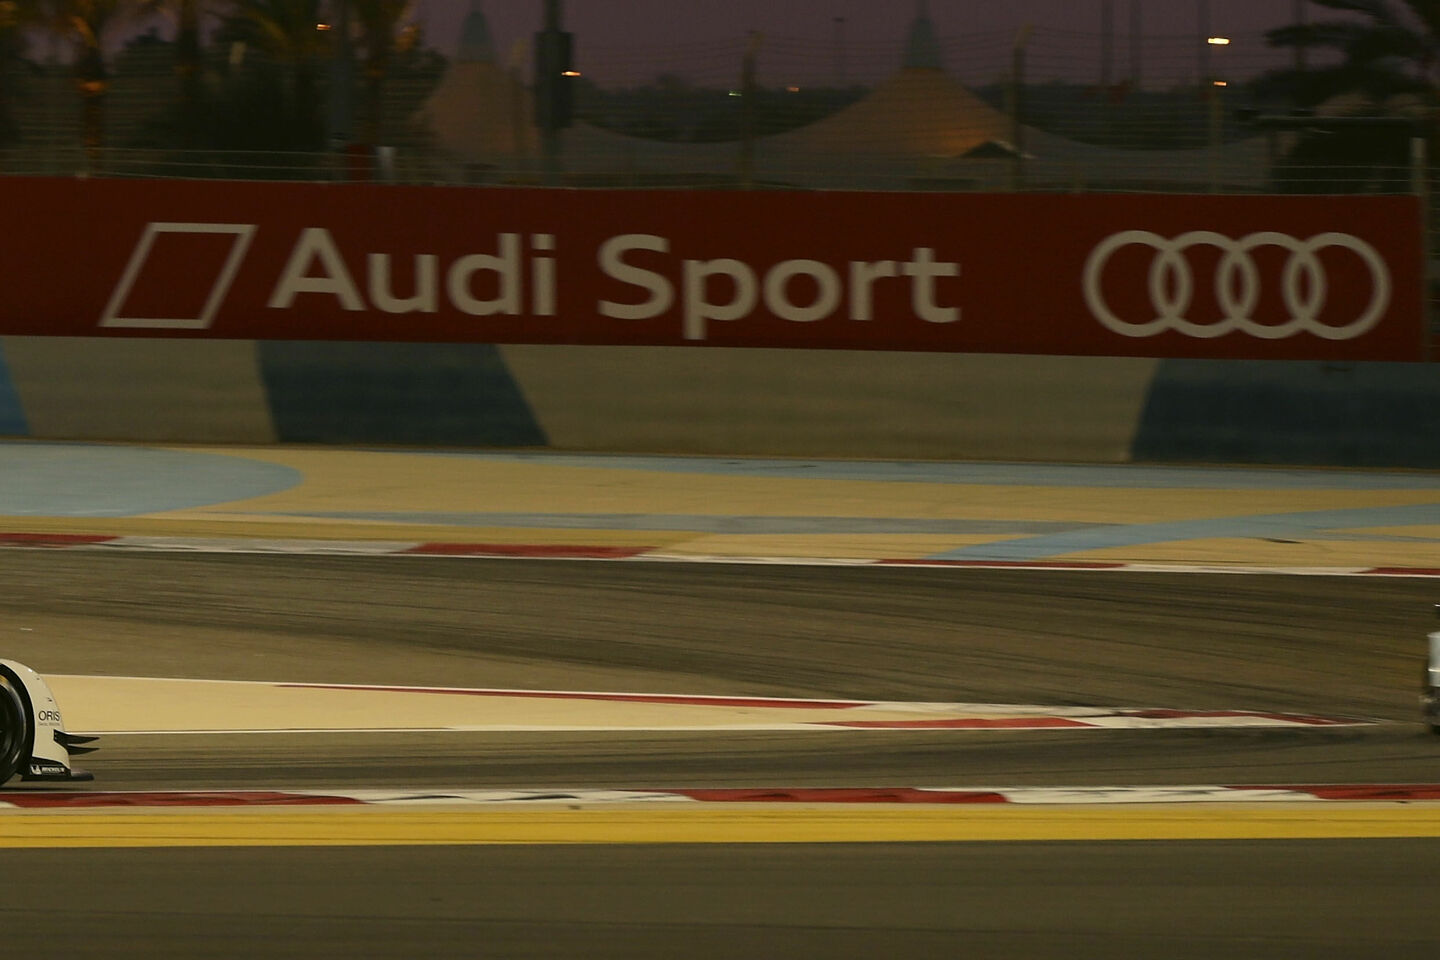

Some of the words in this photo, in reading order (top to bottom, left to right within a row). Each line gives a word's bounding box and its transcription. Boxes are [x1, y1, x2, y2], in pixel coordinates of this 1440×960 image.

[269, 227, 558, 315] Audi
[596, 233, 962, 341] Sport
[38, 710, 61, 722] ORIS
